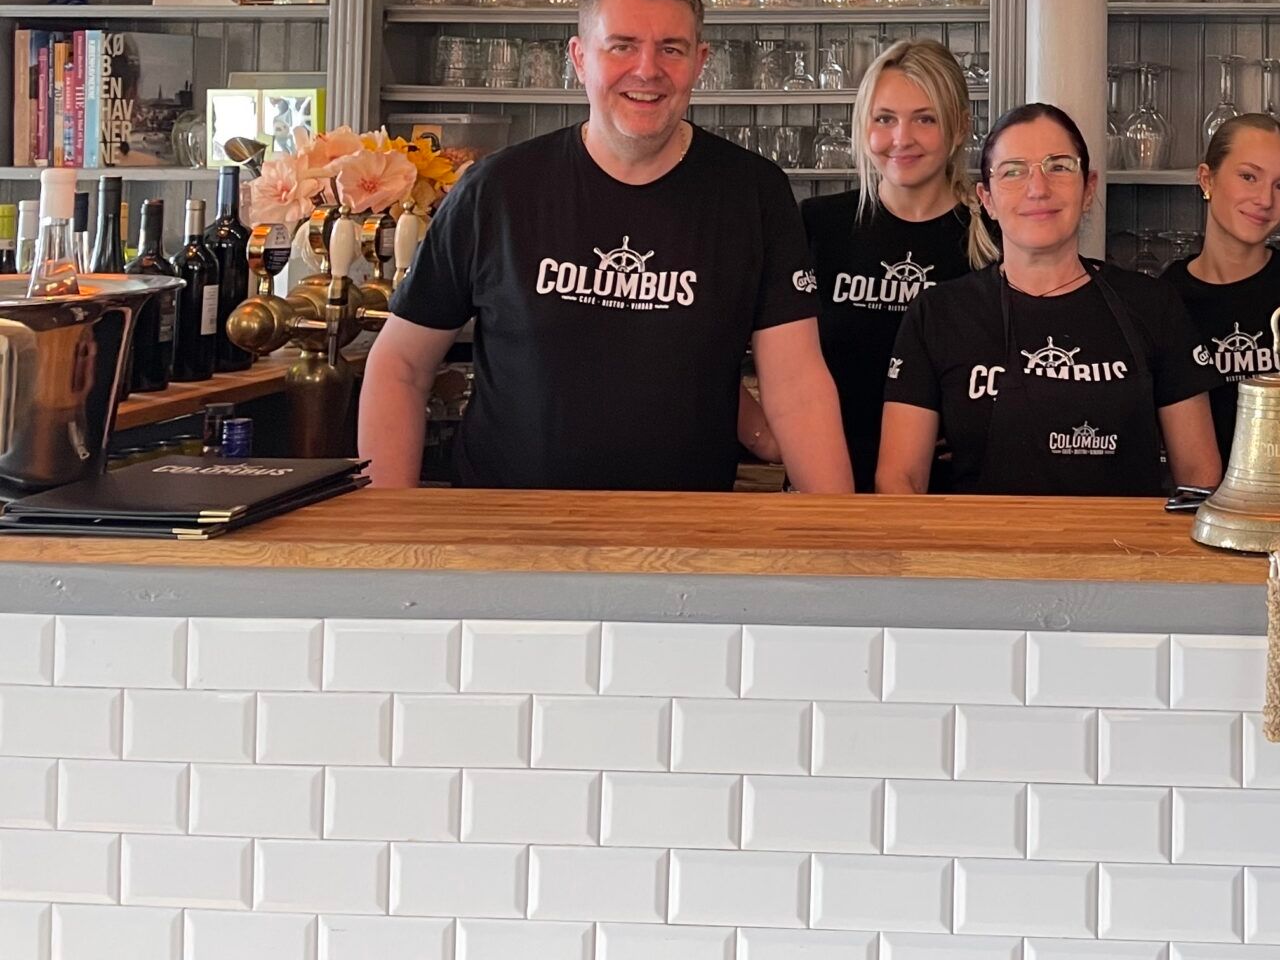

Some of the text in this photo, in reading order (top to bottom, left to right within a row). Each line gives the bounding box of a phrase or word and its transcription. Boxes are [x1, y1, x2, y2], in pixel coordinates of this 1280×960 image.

[102, 33, 124, 57] KØ
[102, 55, 112, 76] B
[102, 77, 122, 99] EN
[101, 99, 134, 121] HAV
[101, 120, 132, 142] NER
[536, 258, 697, 306] COLUMBUS
[832, 272, 937, 303] COLUM
[1049, 431, 1118, 450] COLUMBUS
[152, 465, 294, 476] COLUMBUS
